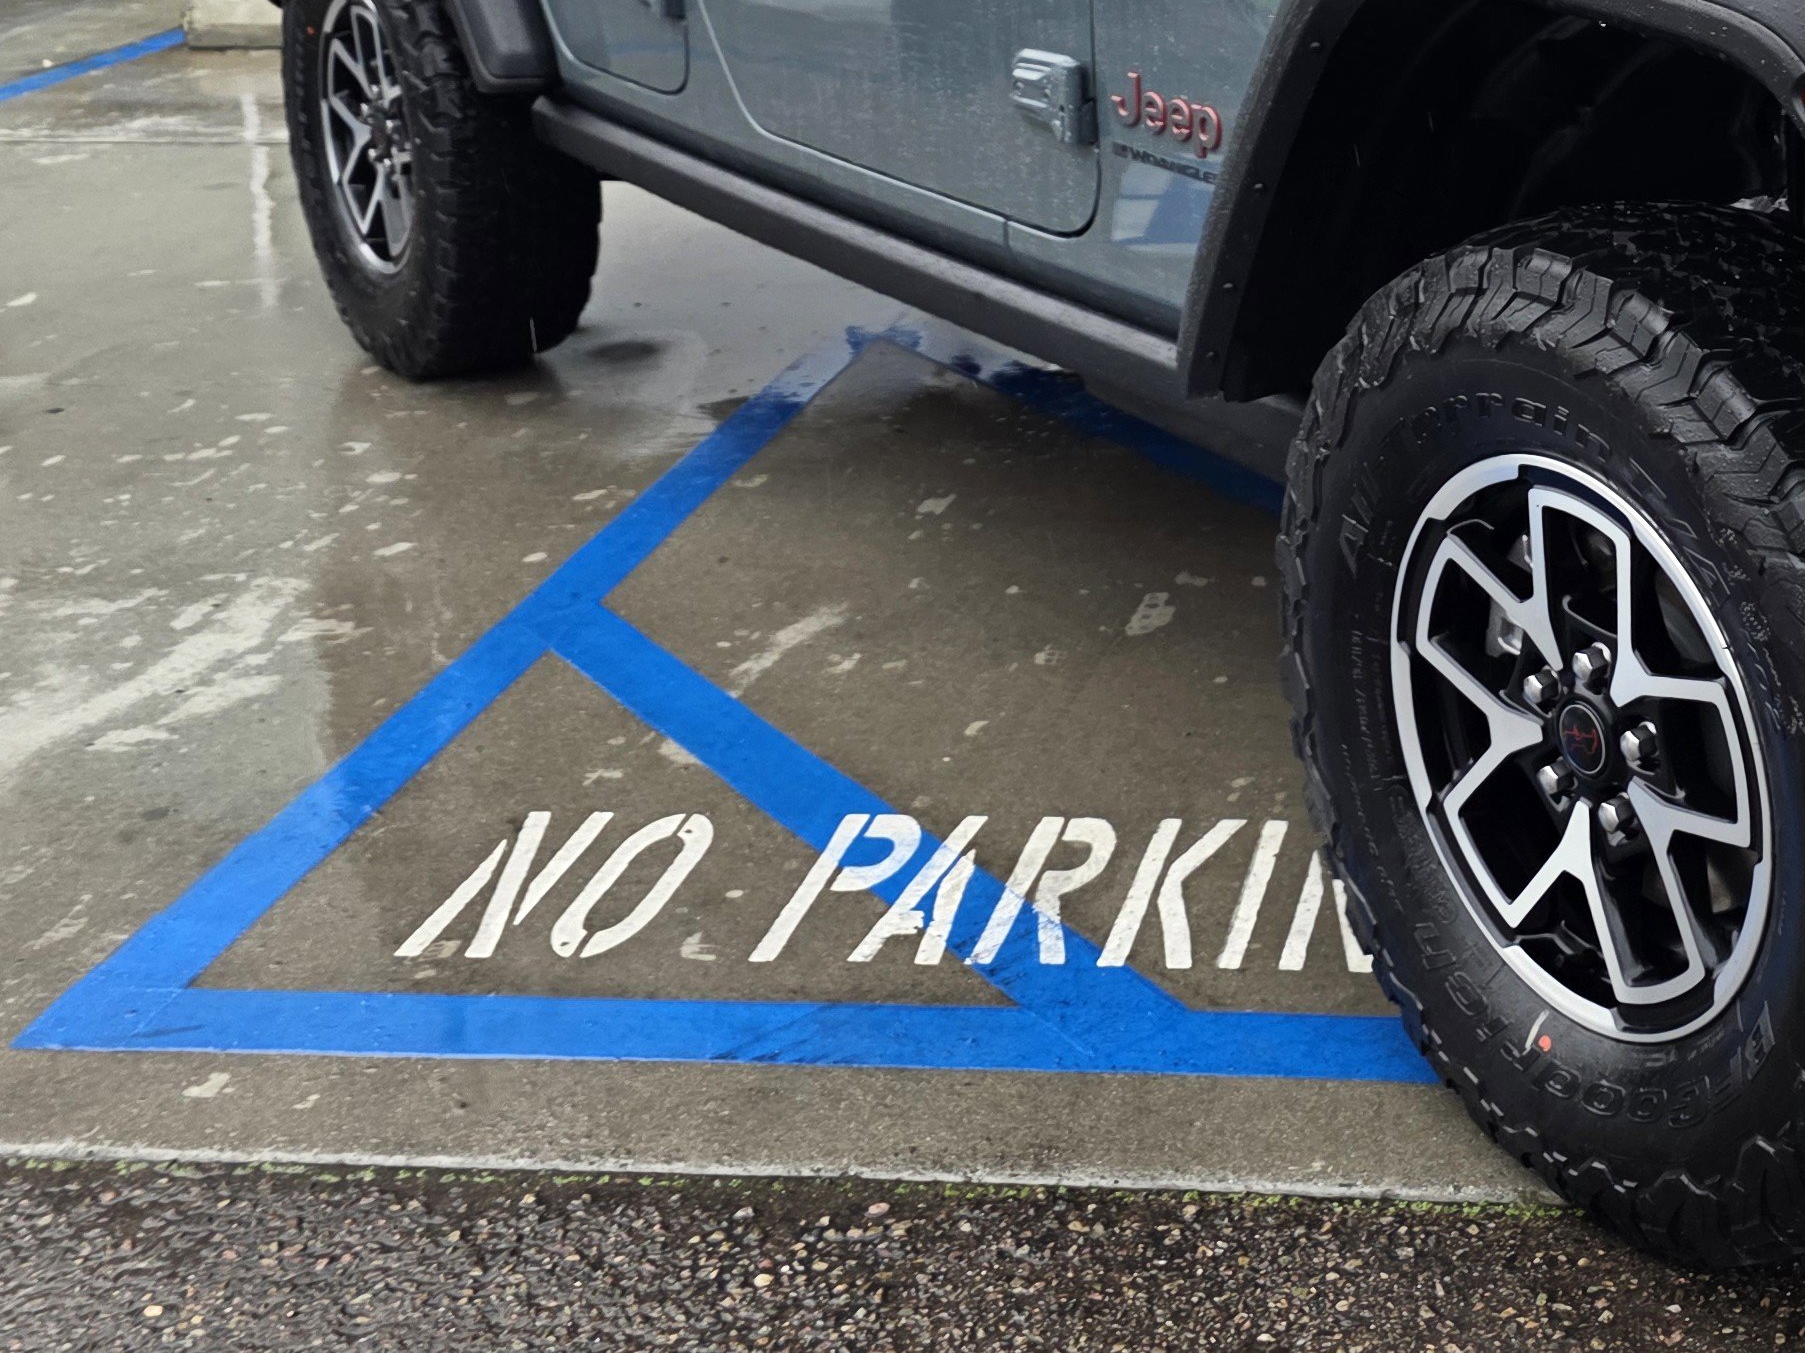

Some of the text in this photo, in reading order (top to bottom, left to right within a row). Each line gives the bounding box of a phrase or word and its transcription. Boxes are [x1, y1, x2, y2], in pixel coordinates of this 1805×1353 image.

[1110, 71, 1223, 159] Jeep
[393, 810, 714, 959] NO
[747, 812, 1375, 974] PARKIN
